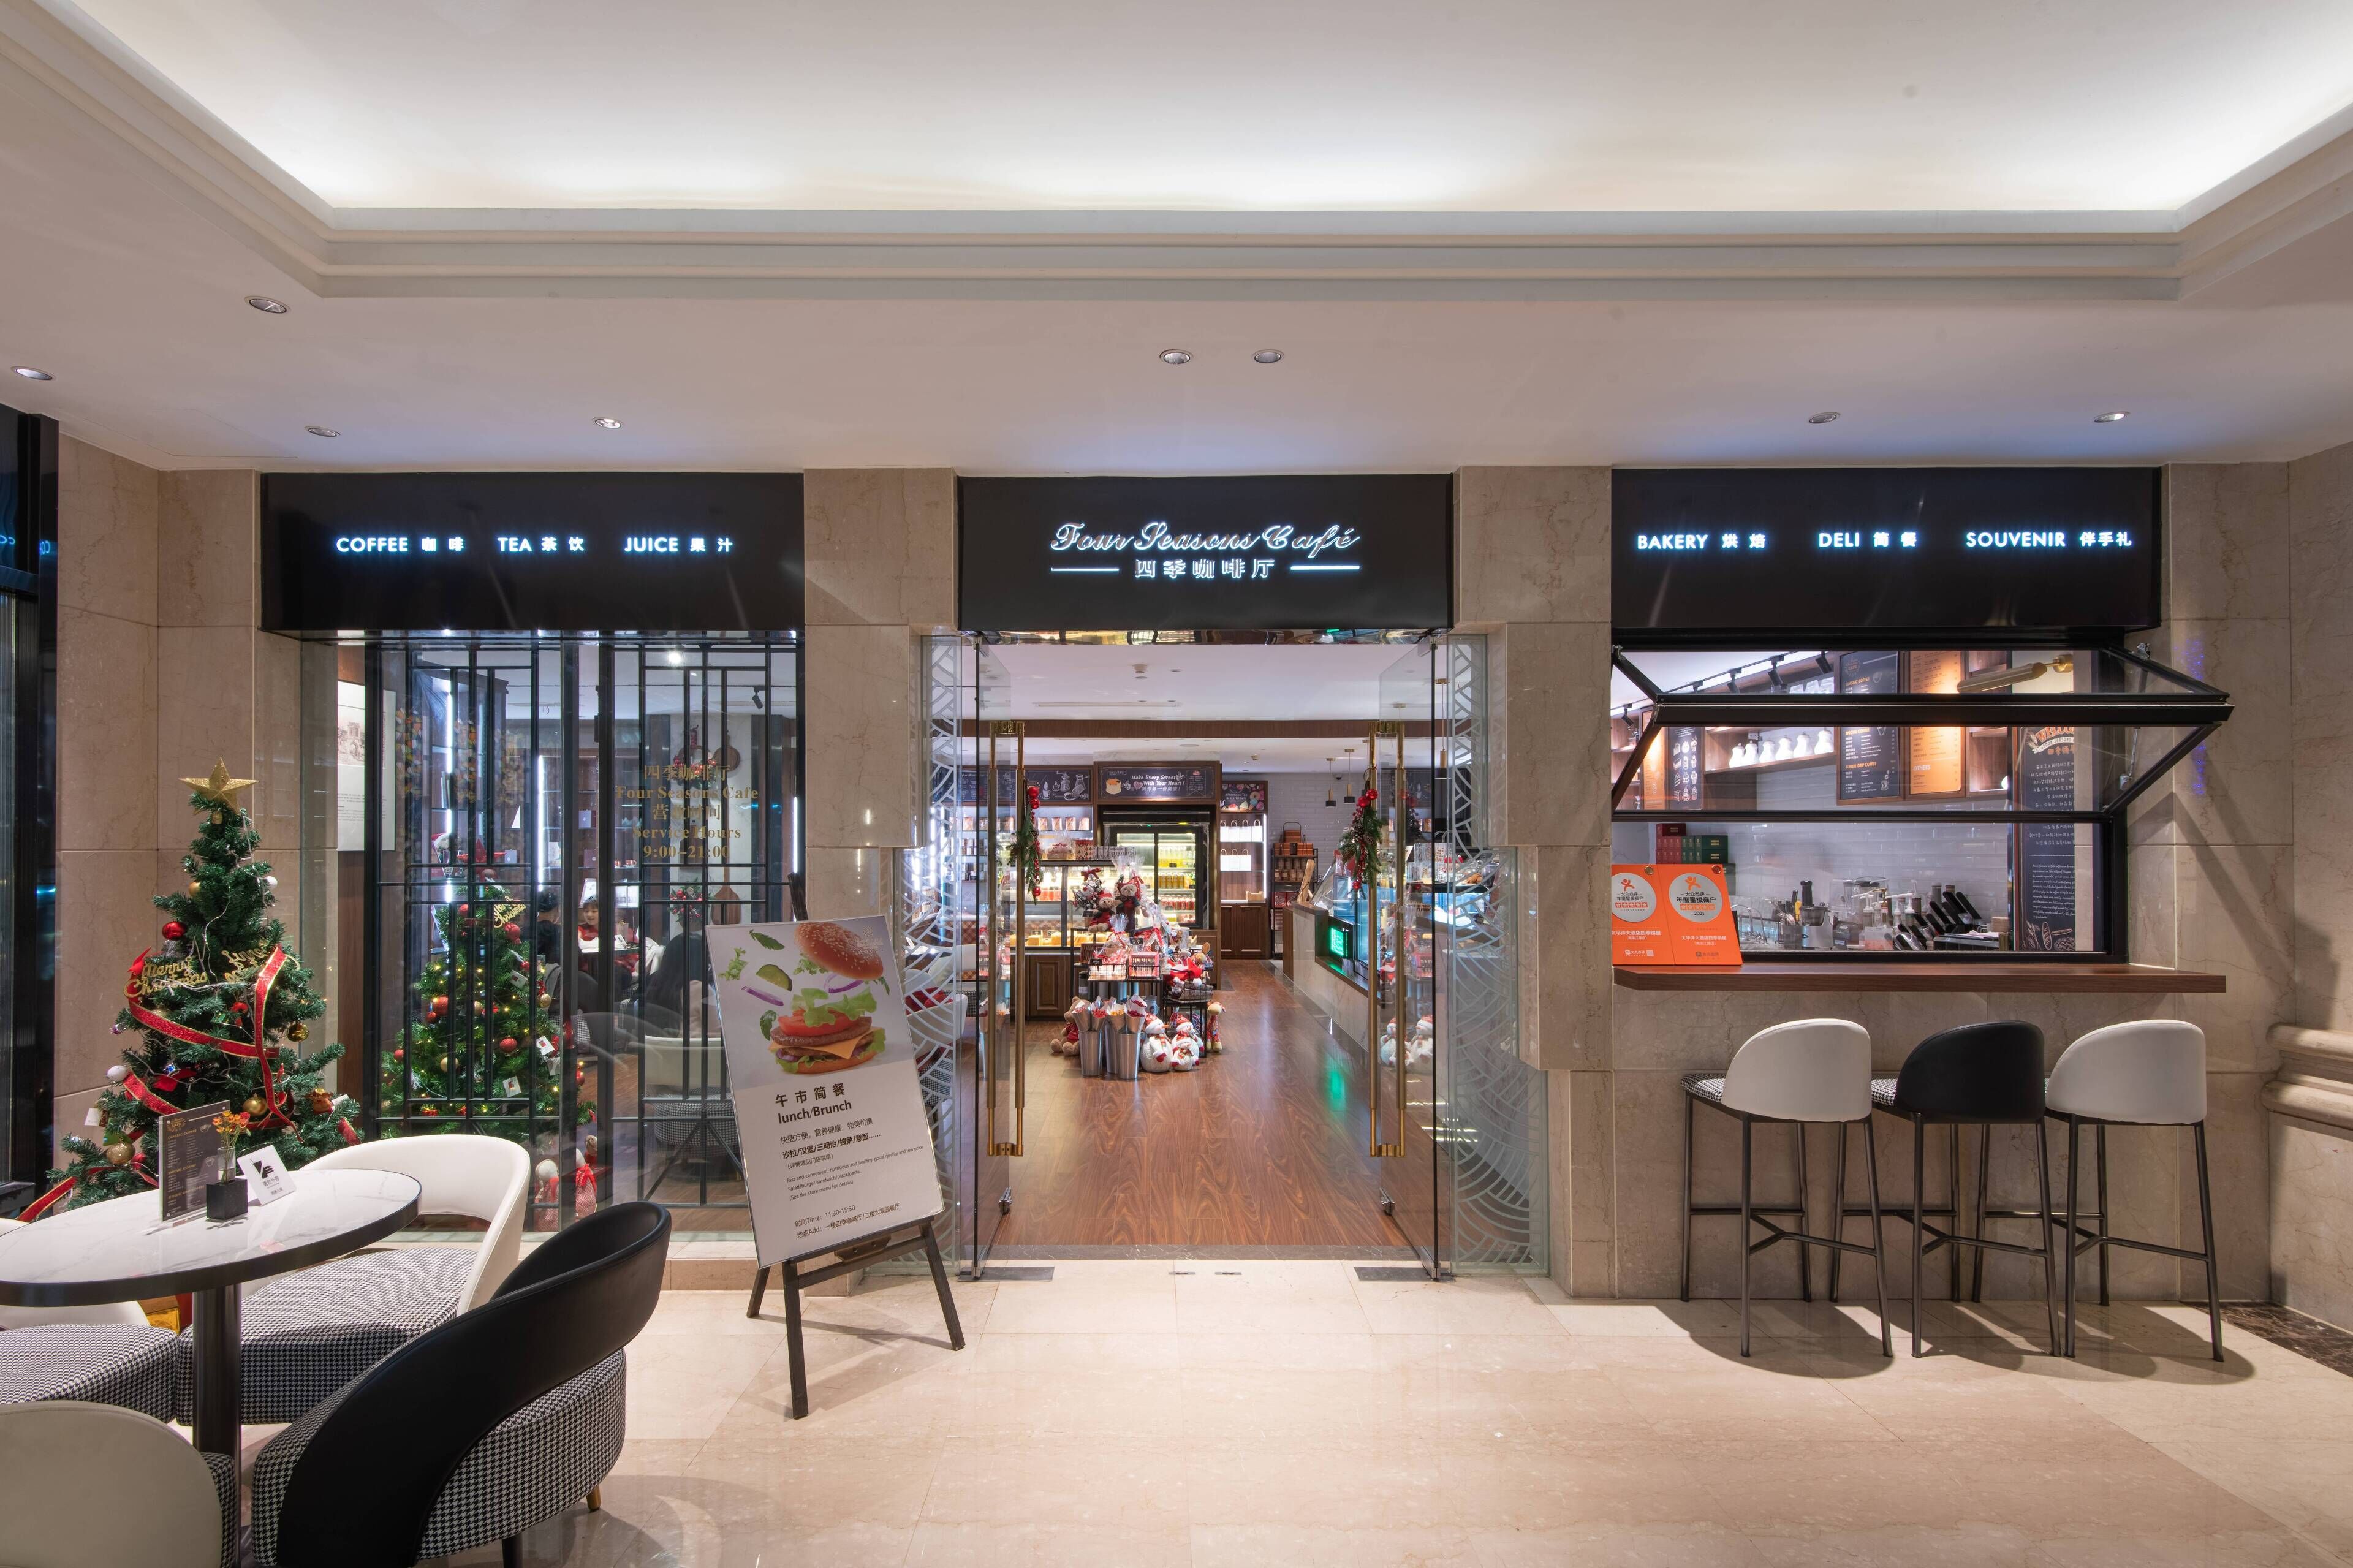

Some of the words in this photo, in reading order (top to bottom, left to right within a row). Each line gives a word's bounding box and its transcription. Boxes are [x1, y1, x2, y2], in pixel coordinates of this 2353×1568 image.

[336, 537, 407, 552] COFFEE
[422, 537, 464, 551] 咖啡
[498, 537, 532, 551] TEA
[541, 537, 584, 551] 茶饮
[624, 537, 678, 552] JUICE
[690, 538, 732, 552] 果汁
[1050, 522, 1134, 550] Four
[1134, 521, 1261, 550] Seasons
[1261, 525, 1361, 558] Café
[1638, 534, 1708, 549] BAKERY
[1722, 534, 1765, 548] 烘焙
[1819, 532, 1859, 547] DELI
[1873, 532, 1917, 547] 简餐
[1966, 532, 2065, 547] SOUVENIR
[2080, 532, 2132, 546] 伴手礼
[1135, 559, 1275, 578] 四季咖啡厅
[616, 786, 653, 799] Four
[657, 785, 719, 799] Seasons
[722, 785, 759, 799] Cafe
[632, 827, 690, 839] Service
[692, 825, 741, 838] Hours
[775, 1082, 845, 1108] 午市简餐
[778, 1100, 852, 1124] lunch/Brunch
[829, 1164, 850, 1175] nutritious
[874, 1155, 885, 1164] good
[885, 1152, 898, 1162] quality
[914, 1145, 924, 1154] price
[789, 1193, 799, 1202] (See
[807, 1189, 819, 1197] store
[838, 1179, 854, 1190] details)
[825, 1205, 856, 1219] 11:30-15:30
